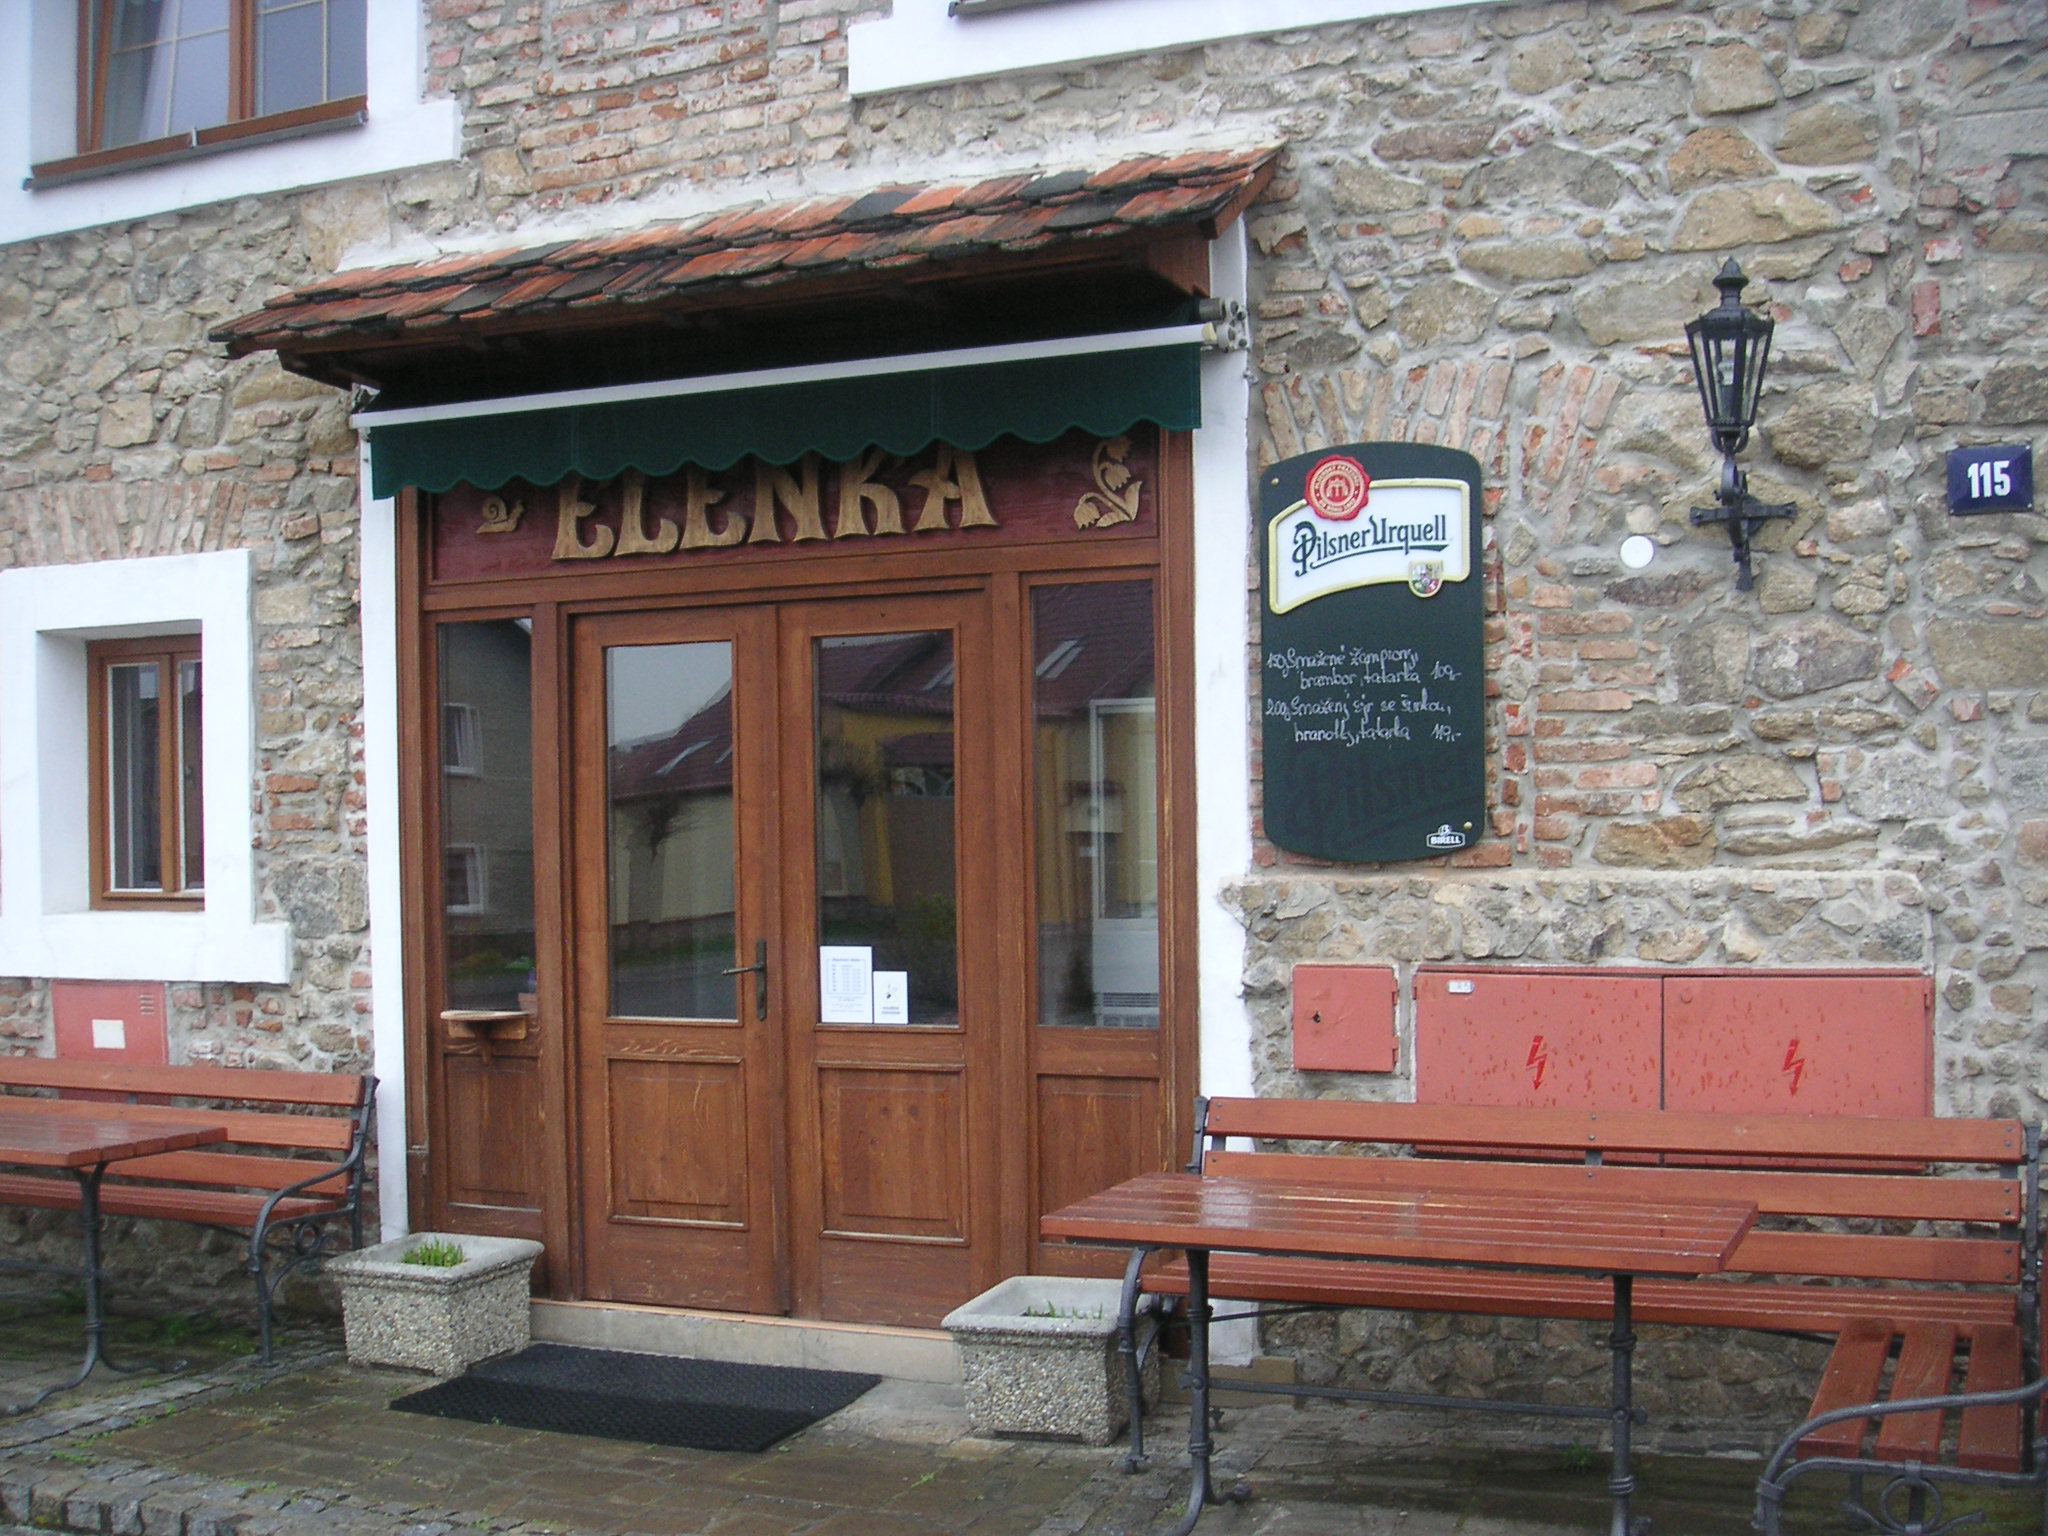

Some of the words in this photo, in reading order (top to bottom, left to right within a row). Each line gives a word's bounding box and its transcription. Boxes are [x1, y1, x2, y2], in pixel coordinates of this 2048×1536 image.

[552, 449, 1000, 561] ELENKA
[1967, 460, 2011, 499] 115
[1292, 520, 1370, 577] Pilsner
[1369, 514, 1447, 555] Urquell
[1380, 700, 1396, 712] se
